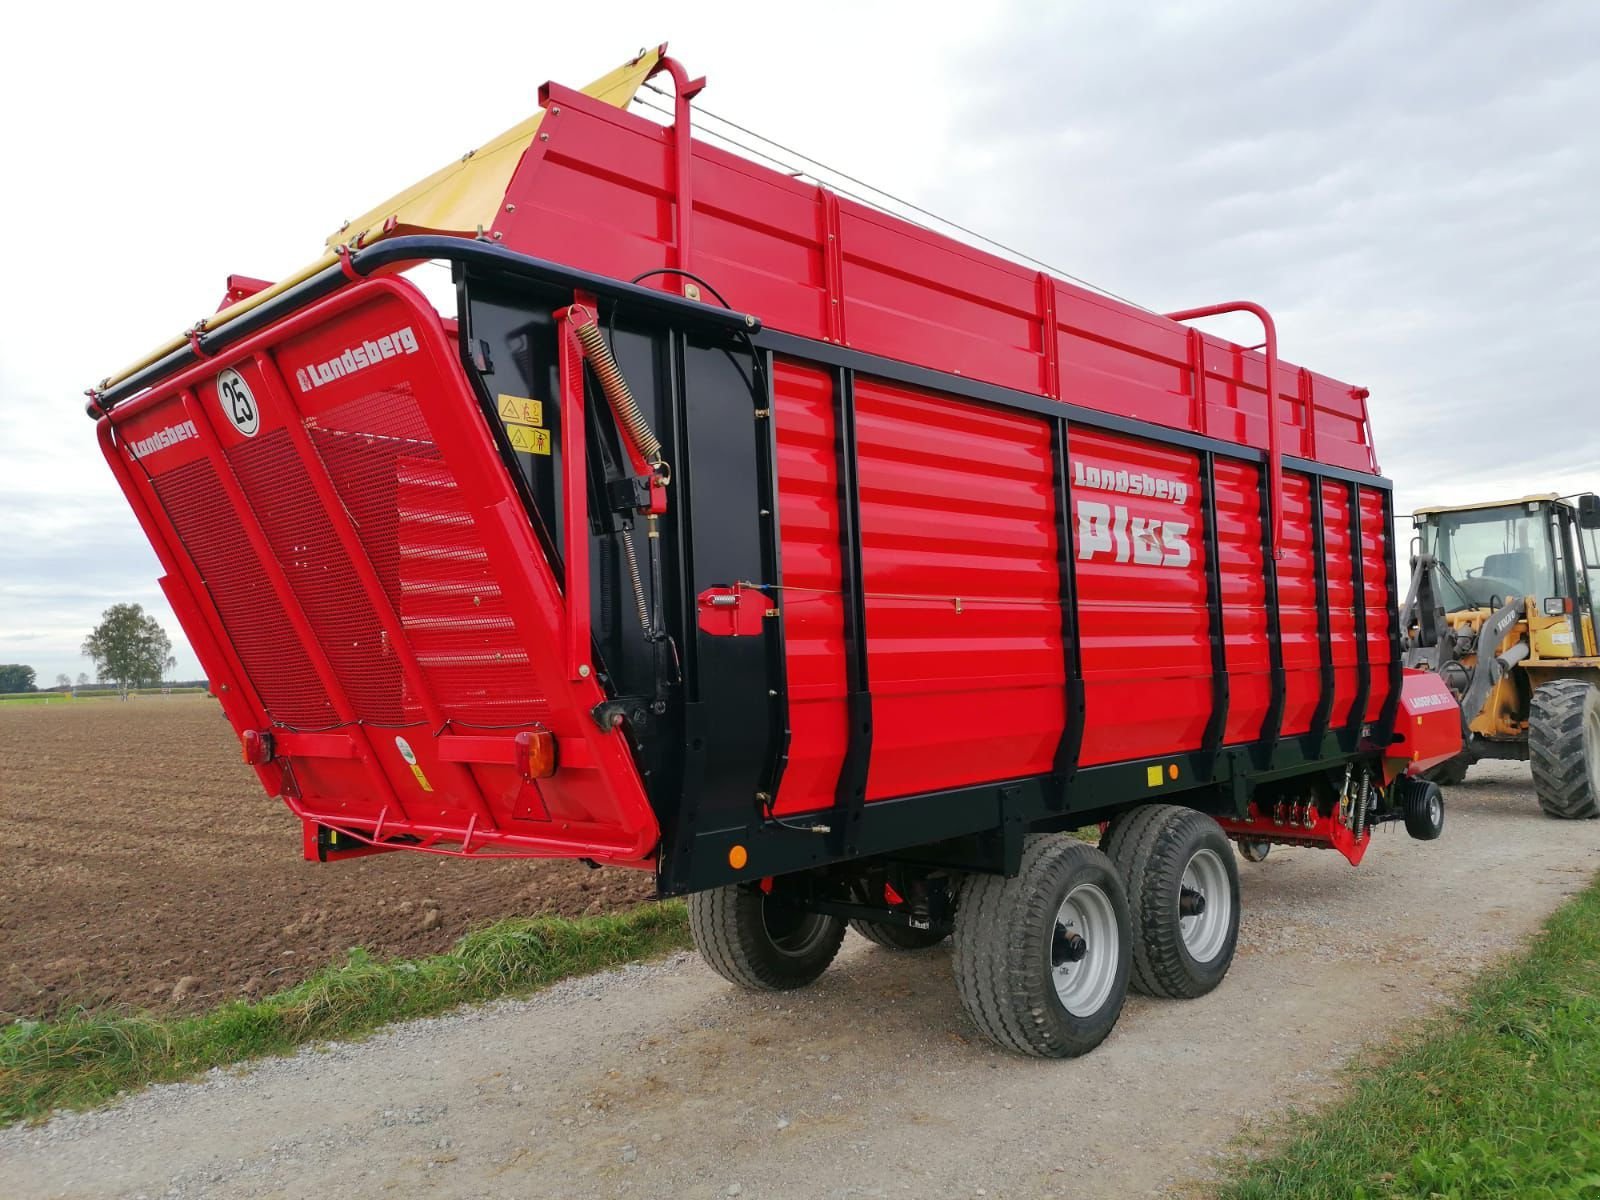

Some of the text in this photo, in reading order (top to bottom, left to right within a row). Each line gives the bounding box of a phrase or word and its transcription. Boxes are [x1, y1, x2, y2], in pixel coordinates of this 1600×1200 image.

[306, 326, 419, 387] Landsberg
[222, 378, 254, 424] 25
[1074, 461, 1188, 505] Landsberg
